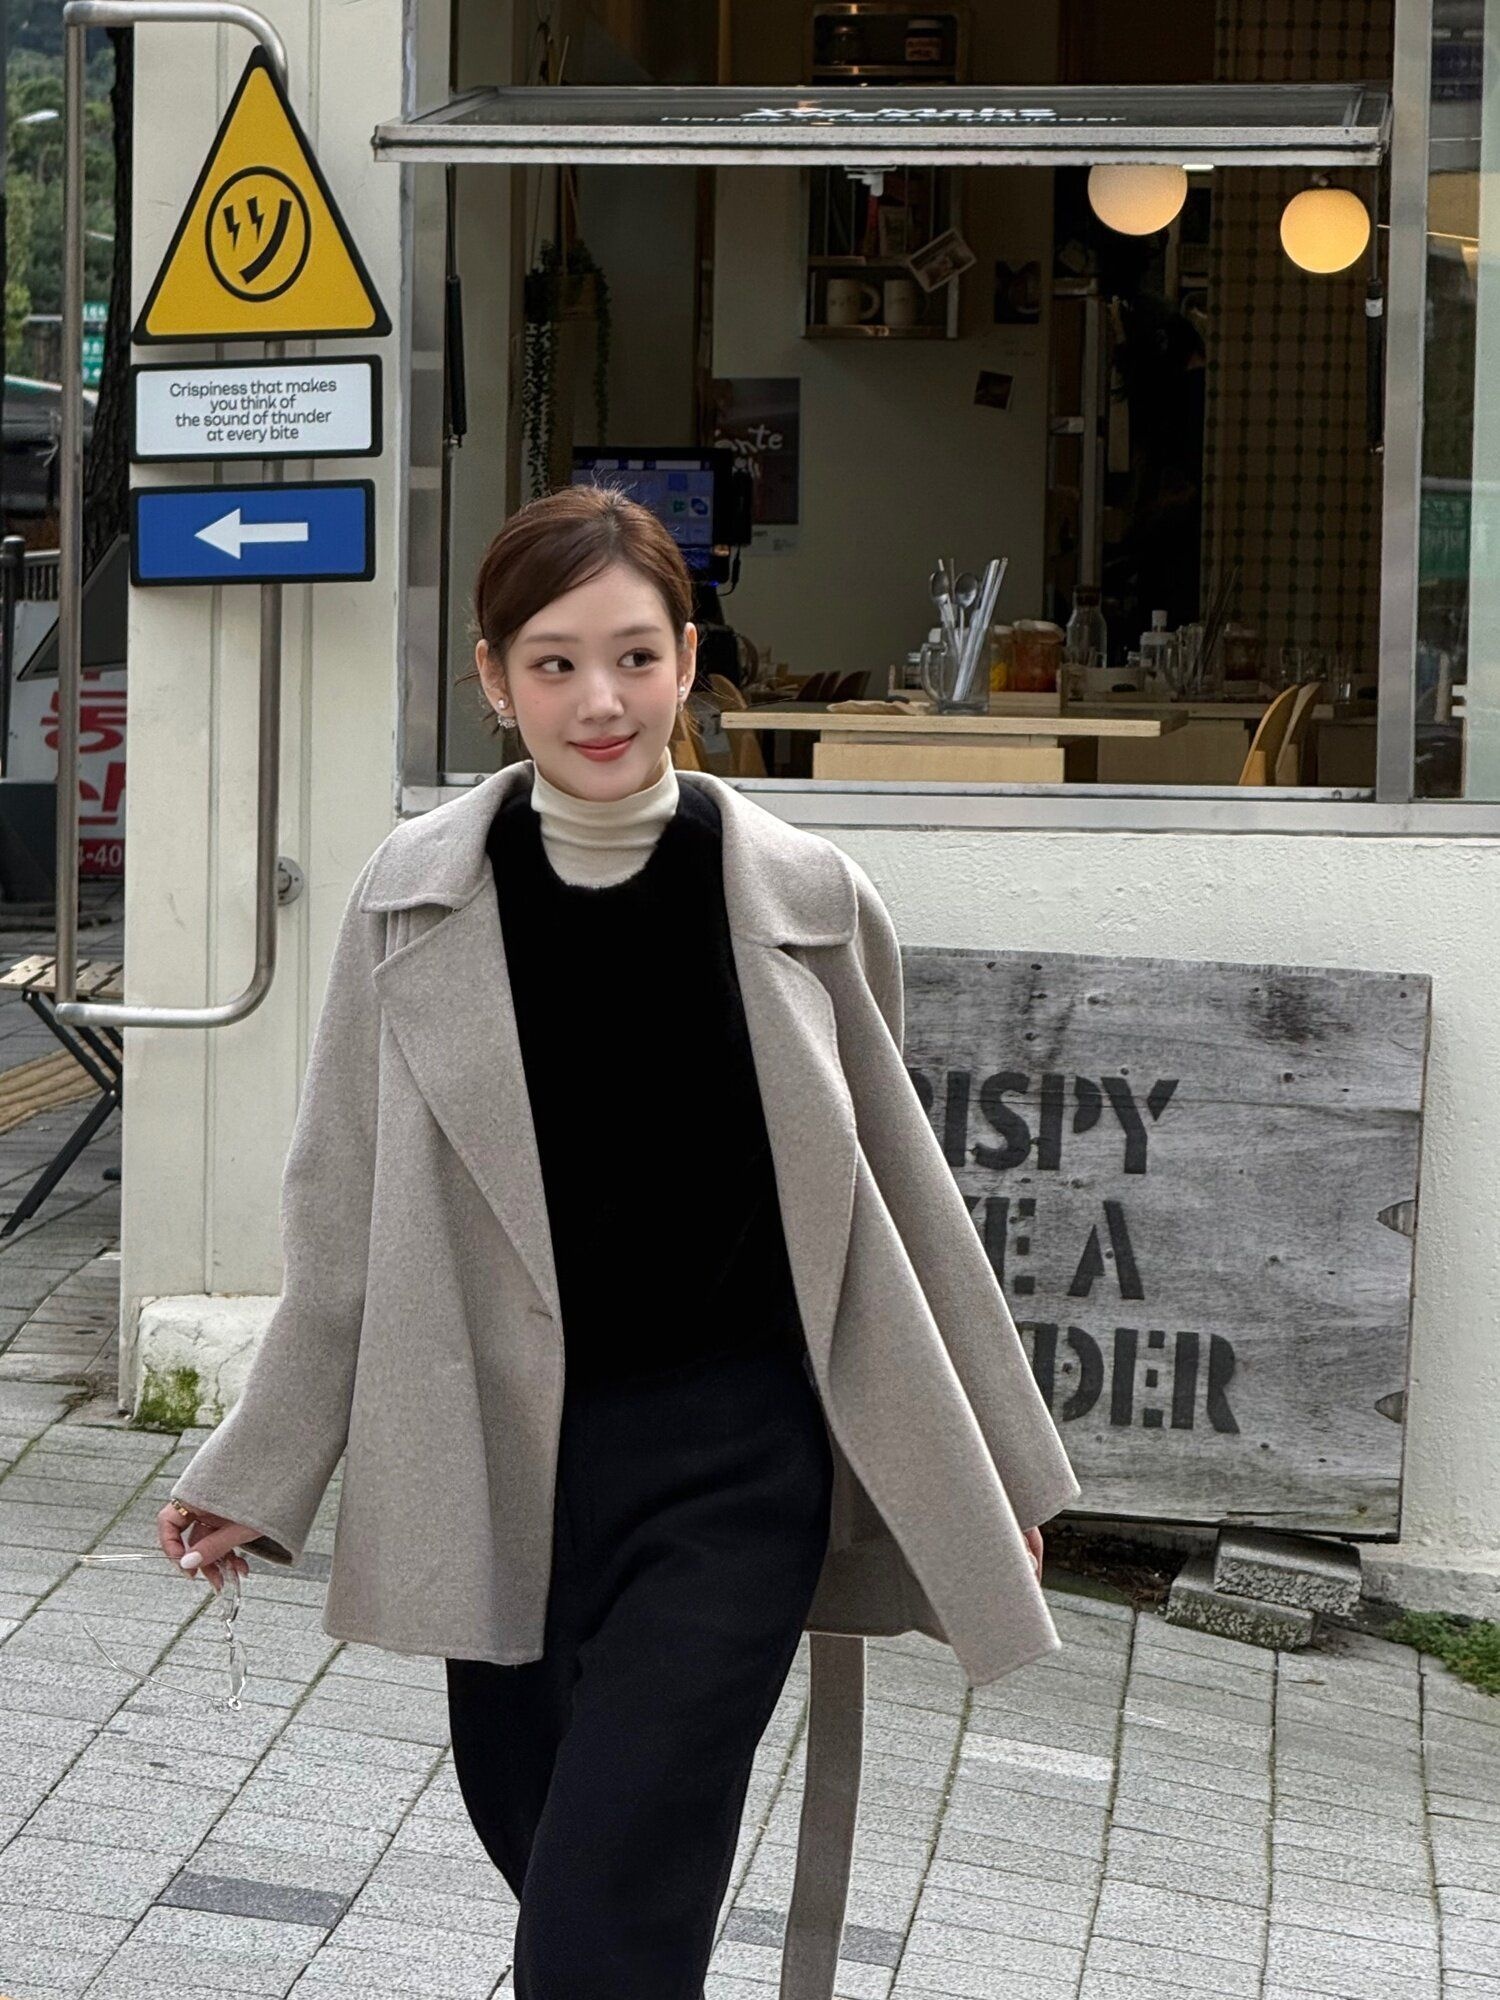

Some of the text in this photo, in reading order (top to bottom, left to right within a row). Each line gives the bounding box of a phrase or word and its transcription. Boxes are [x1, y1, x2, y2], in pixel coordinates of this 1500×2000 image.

[169, 377, 337, 399] Crispiness that makes
[210, 394, 296, 414] you think of
[175, 408, 332, 427] the sound of thunder
[207, 425, 299, 443] at every bite
[1066, 1200, 1145, 1300] A
